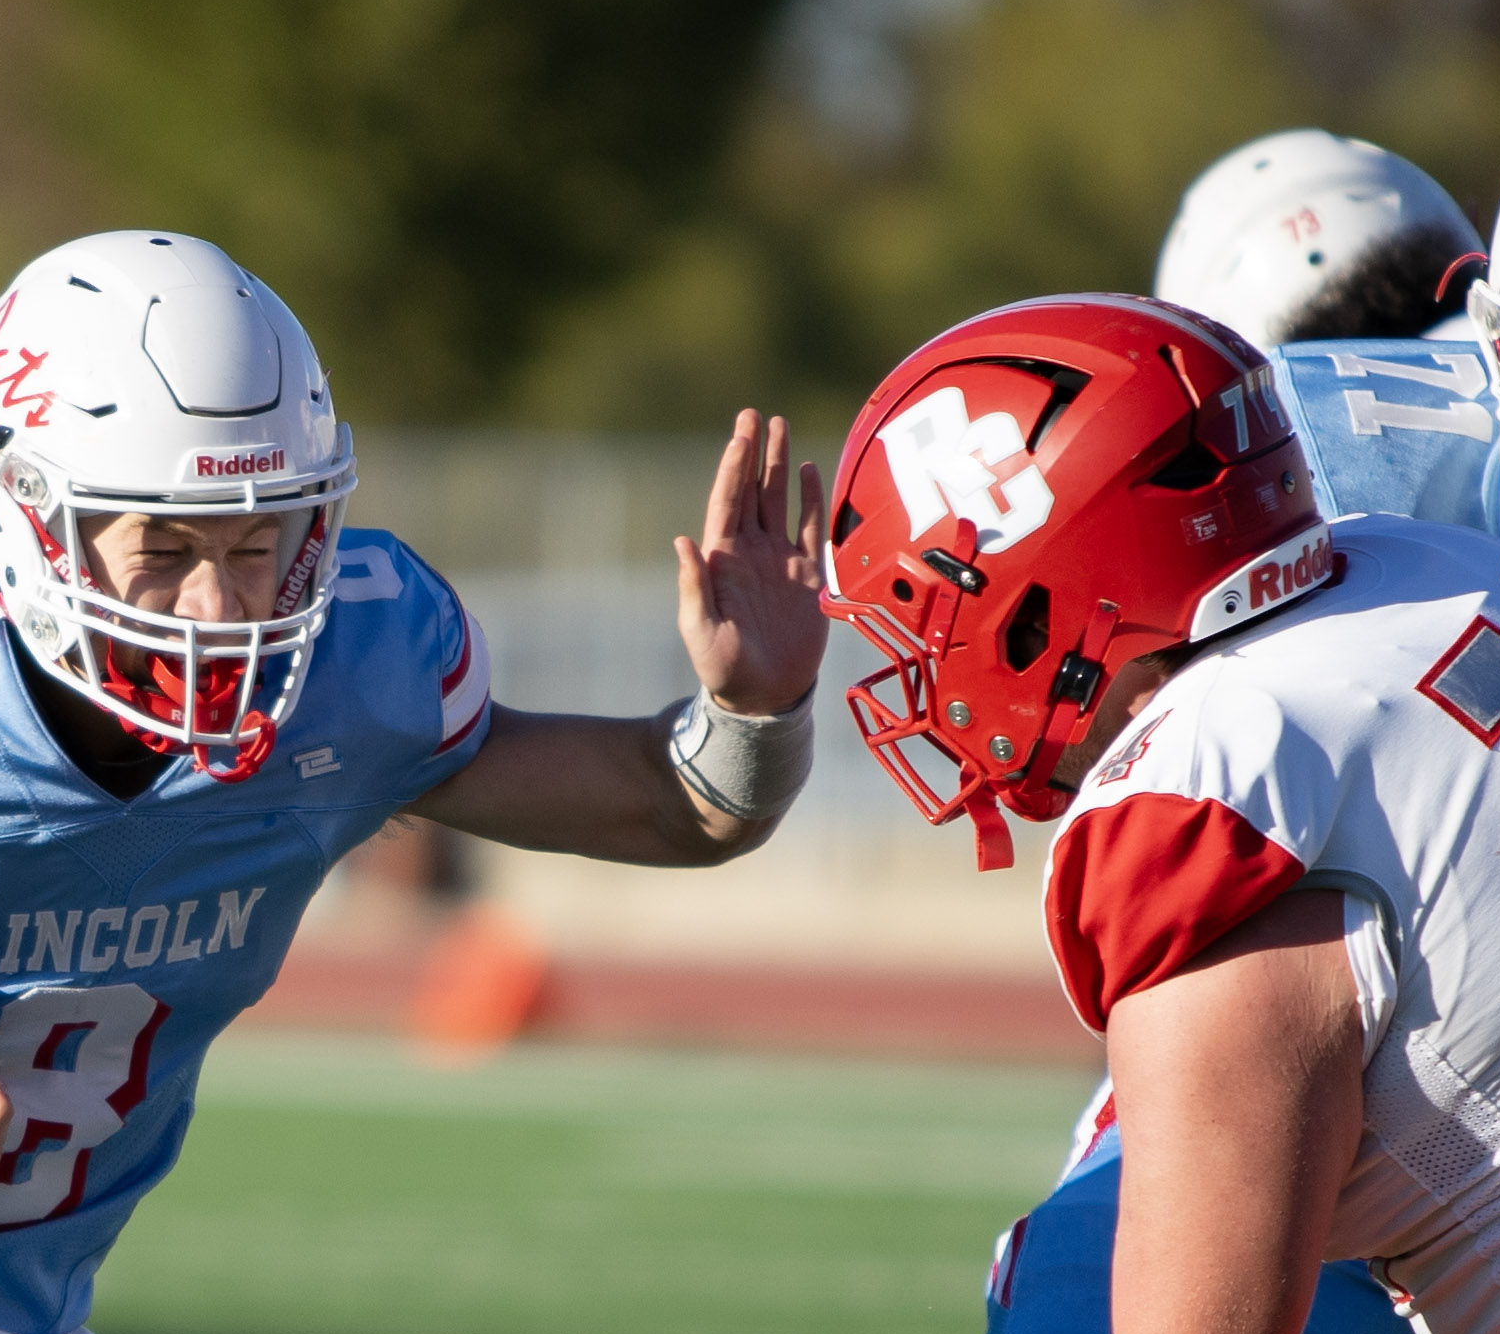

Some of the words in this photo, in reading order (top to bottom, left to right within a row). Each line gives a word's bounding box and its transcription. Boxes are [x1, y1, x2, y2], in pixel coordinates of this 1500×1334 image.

[195, 449, 286, 476] Riddell
[274, 537, 321, 615] Riddell
[1248, 537, 1334, 610] Ridd
